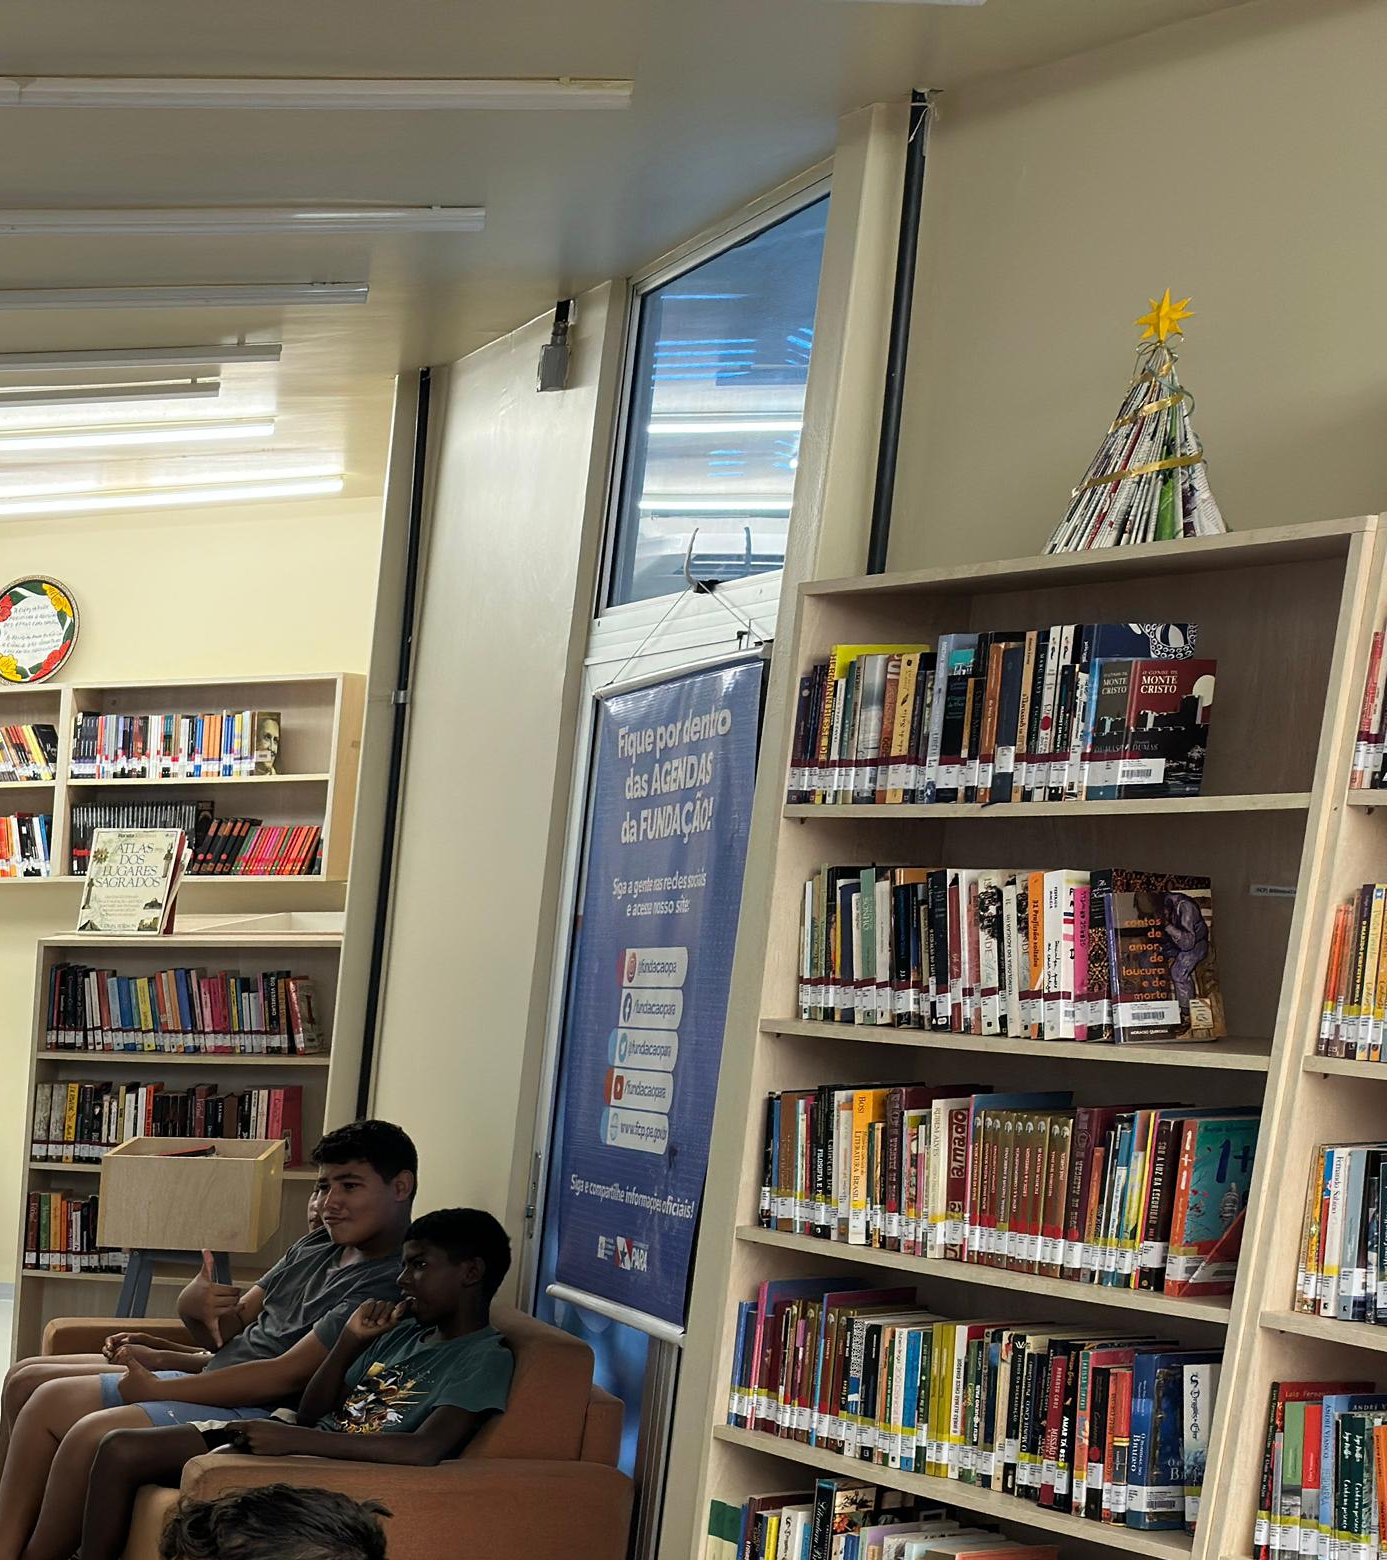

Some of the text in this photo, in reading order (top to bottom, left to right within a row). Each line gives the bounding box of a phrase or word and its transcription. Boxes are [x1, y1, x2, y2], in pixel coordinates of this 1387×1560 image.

[1142, 676, 1177, 684] MONTE
[822, 655, 836, 737] HERMANN HESSE
[1102, 686, 1127, 695] CRISTO
[1140, 684, 1177, 694] CRISTO
[618, 705, 731, 763] Fique por dentro
[625, 752, 713, 799] das AGENDAS
[621, 790, 714, 844] da FUNDAÇÃO!
[117, 843, 154, 853] ATLAS
[120, 854, 144, 864] DOS
[103, 866, 158, 876] LUGARES
[94, 877, 161, 887] SAGRADOS
[613, 878, 626, 899] Siga
[633, 876, 652, 898] gente
[663, 871, 687, 892] redes
[687, 868, 706, 888] sociais
[653, 900, 674, 915] nosso
[1031, 909, 1039, 940] Profissão
[1124, 918, 1161, 928] contos
[1148, 929, 1162, 938] de
[1129, 943, 1163, 952] amor,
[1150, 954, 1164, 963] de
[1122, 967, 1165, 976] loucura
[1152, 977, 1166, 987] de
[1134, 991, 1167, 1000] morte
[857, 1096, 865, 1113] BOSI
[853, 1131, 861, 1173] LITERATURA
[933, 1135, 941, 1156] ALVES
[951, 1110, 965, 1178] amado
[1156, 1164, 1164, 1175] LUZ
[1331, 1156, 1345, 1214] Fernando Sabino
[571, 1174, 584, 1196] Siga
[589, 1183, 625, 1202] compartilhe
[661, 1195, 695, 1218] oficiais!
[1055, 1367, 1063, 1392] ROBERTO
[1023, 1400, 1031, 1420] CINCO
[1048, 1428, 1059, 1455] MISSÃO
[1061, 1438, 1068, 1446] TÁ
[1323, 1430, 1331, 1459] VIANCO
[813, 1499, 827, 1543] Literatura
